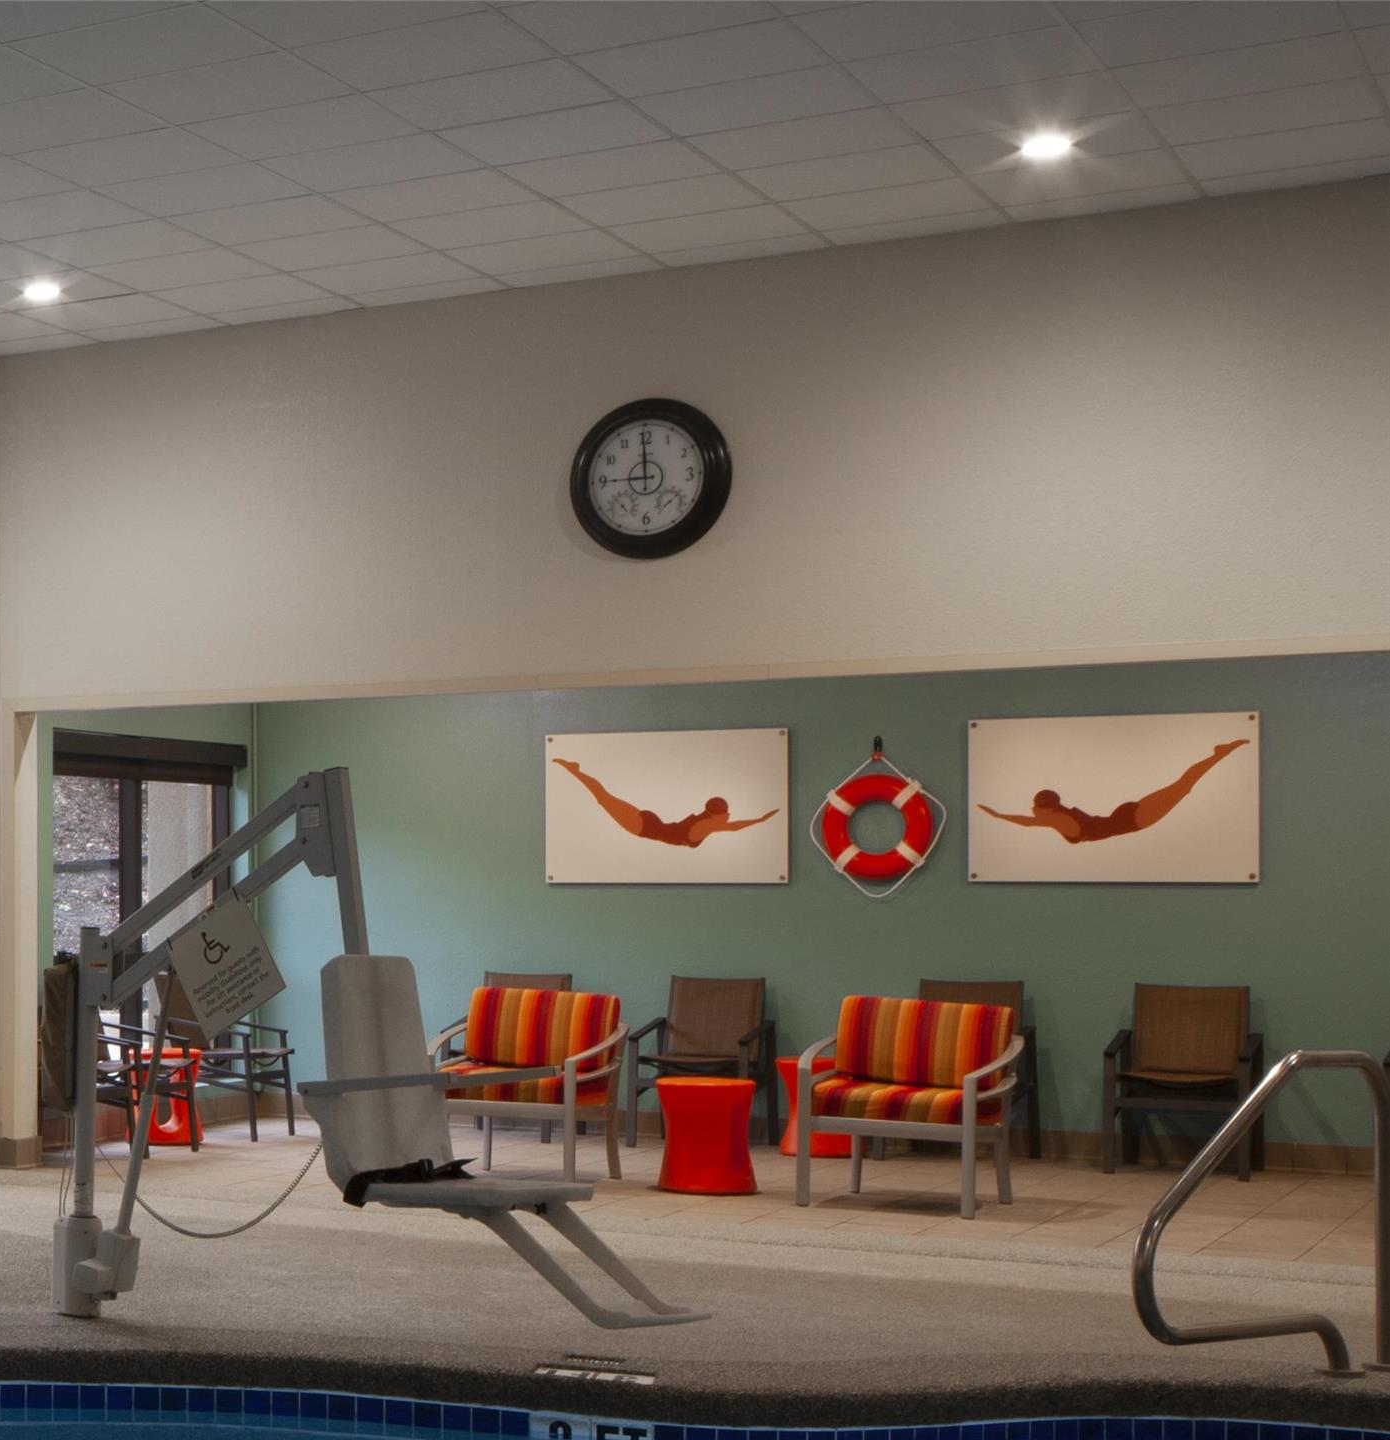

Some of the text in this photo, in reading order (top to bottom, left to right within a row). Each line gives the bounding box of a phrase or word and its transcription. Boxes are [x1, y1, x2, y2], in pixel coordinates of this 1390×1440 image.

[639, 431, 653, 444] 12
[665, 435, 670, 444] 1
[621, 439, 629, 449] 11
[681, 448, 688, 458] 2
[606, 455, 617, 465] 10
[685, 466, 694, 481] 3
[599, 475, 607, 488] 9
[642, 512, 651, 525] 6
[192, 974, 217, 994] Reserved
[216, 968, 226, 978] for
[259, 971, 269, 980] the
